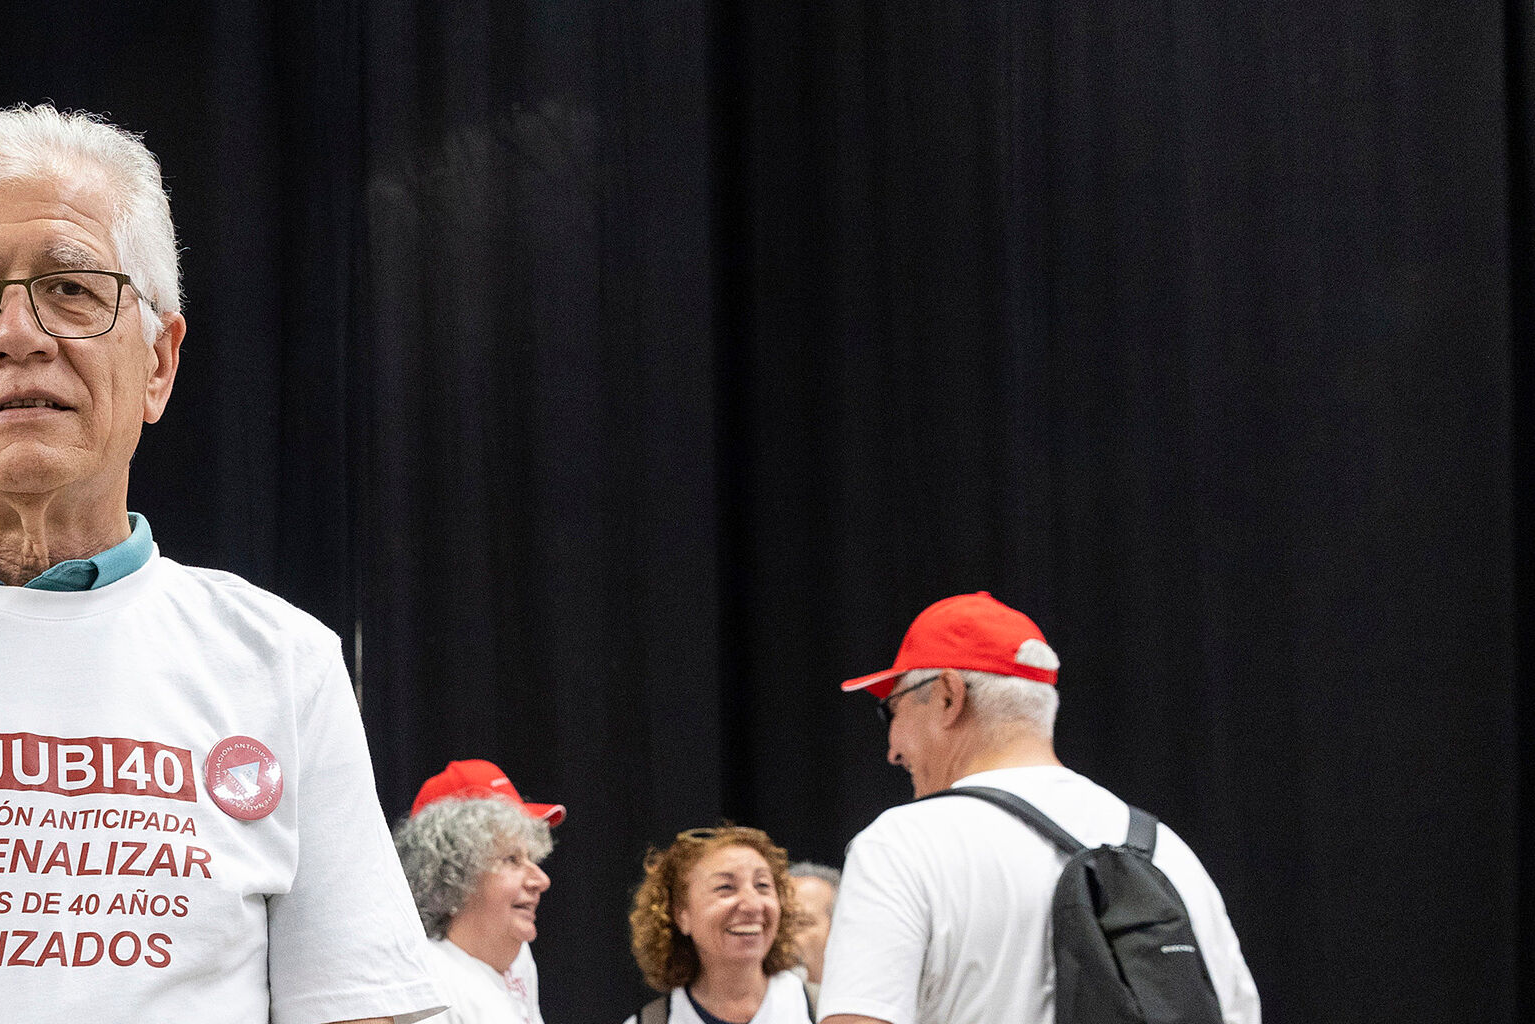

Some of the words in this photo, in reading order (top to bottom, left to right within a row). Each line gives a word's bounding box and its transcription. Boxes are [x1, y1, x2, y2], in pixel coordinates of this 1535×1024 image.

[39, 808, 197, 837] ANTICIPADA
[21, 892, 62, 914] DE
[68, 892, 101, 916] 40
[106, 888, 190, 918] AÑOS
